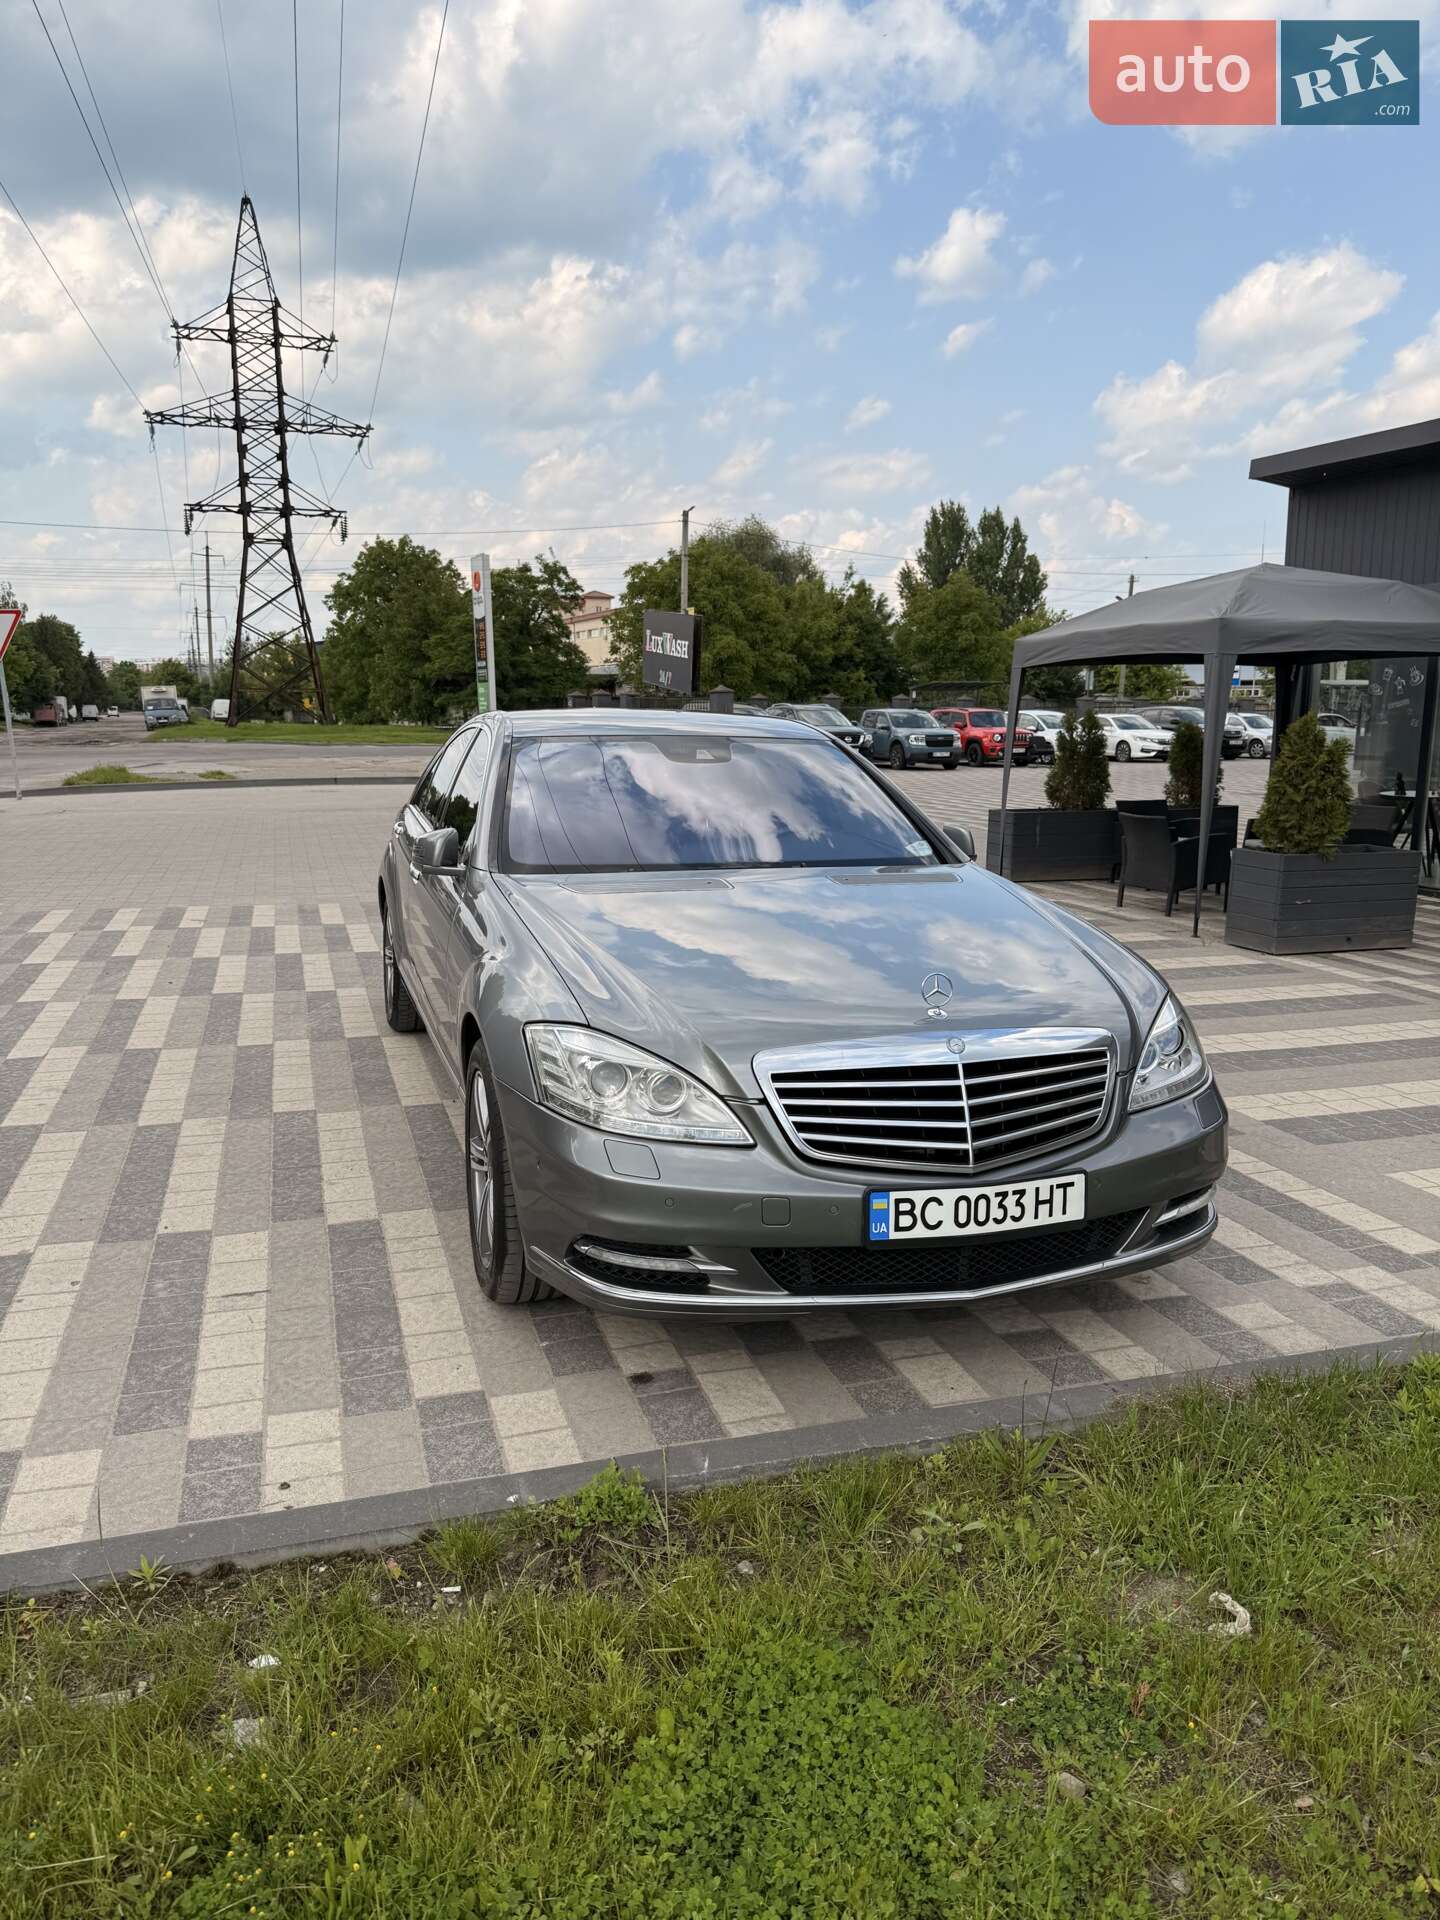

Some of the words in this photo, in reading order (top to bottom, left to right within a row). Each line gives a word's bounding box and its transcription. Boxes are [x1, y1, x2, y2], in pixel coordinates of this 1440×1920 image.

[894, 1196, 943, 1232] BC
[953, 1188, 1026, 1229] 0033
[1034, 1181, 1075, 1220] HT
[872, 1223, 887, 1234] UA
